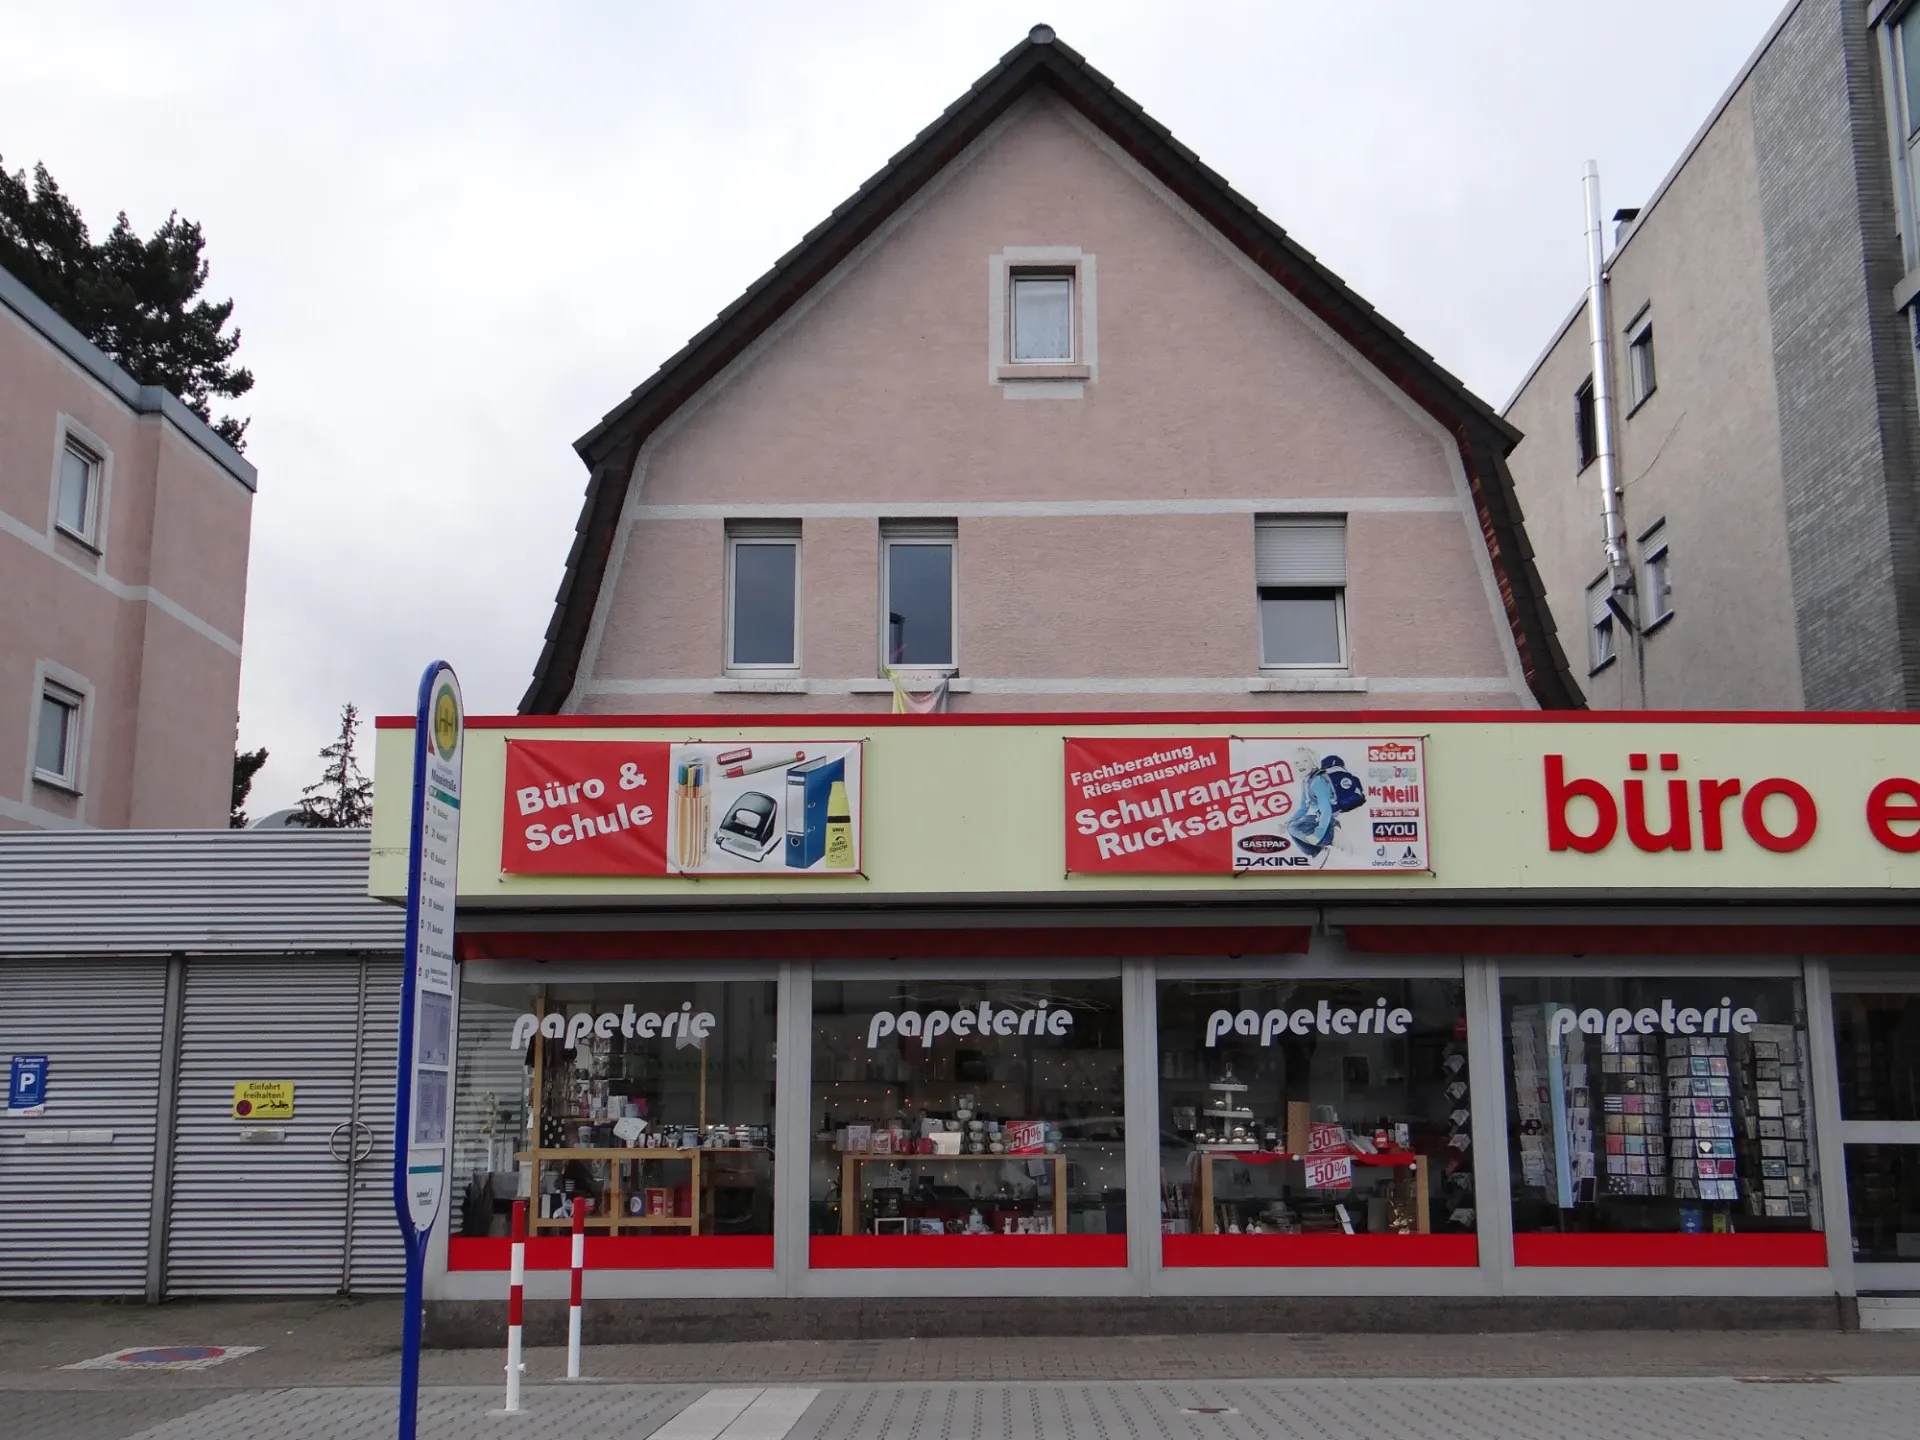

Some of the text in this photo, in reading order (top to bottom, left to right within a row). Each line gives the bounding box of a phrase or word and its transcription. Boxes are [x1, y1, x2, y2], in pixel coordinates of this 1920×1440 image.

[1070, 745, 1194, 786] Fachberatung
[1082, 752, 1217, 799] Riesenauswahl
[1370, 749, 1415, 761] Scout
[516, 762, 647, 815] Büro &
[1075, 762, 1293, 835] Schulranzen
[1544, 753, 1817, 853] büro
[525, 803, 653, 851] Schule
[1096, 793, 1291, 860] Rucksäcke
[1242, 840, 1286, 848] EASTPAK
[1375, 824, 1415, 836] 4YOU
[1234, 856, 1311, 867] DAKINE
[510, 1001, 716, 1050] papeterie
[867, 999, 1073, 1048] papeterie
[1205, 997, 1413, 1047] papeterie
[1549, 996, 1758, 1045] papeterie
[20, 1073, 35, 1092] P
[243, 1091, 285, 1099] freihalten!
[249, 1083, 281, 1091] Einfahrt
[1308, 1160, 1347, 1184] -50%
